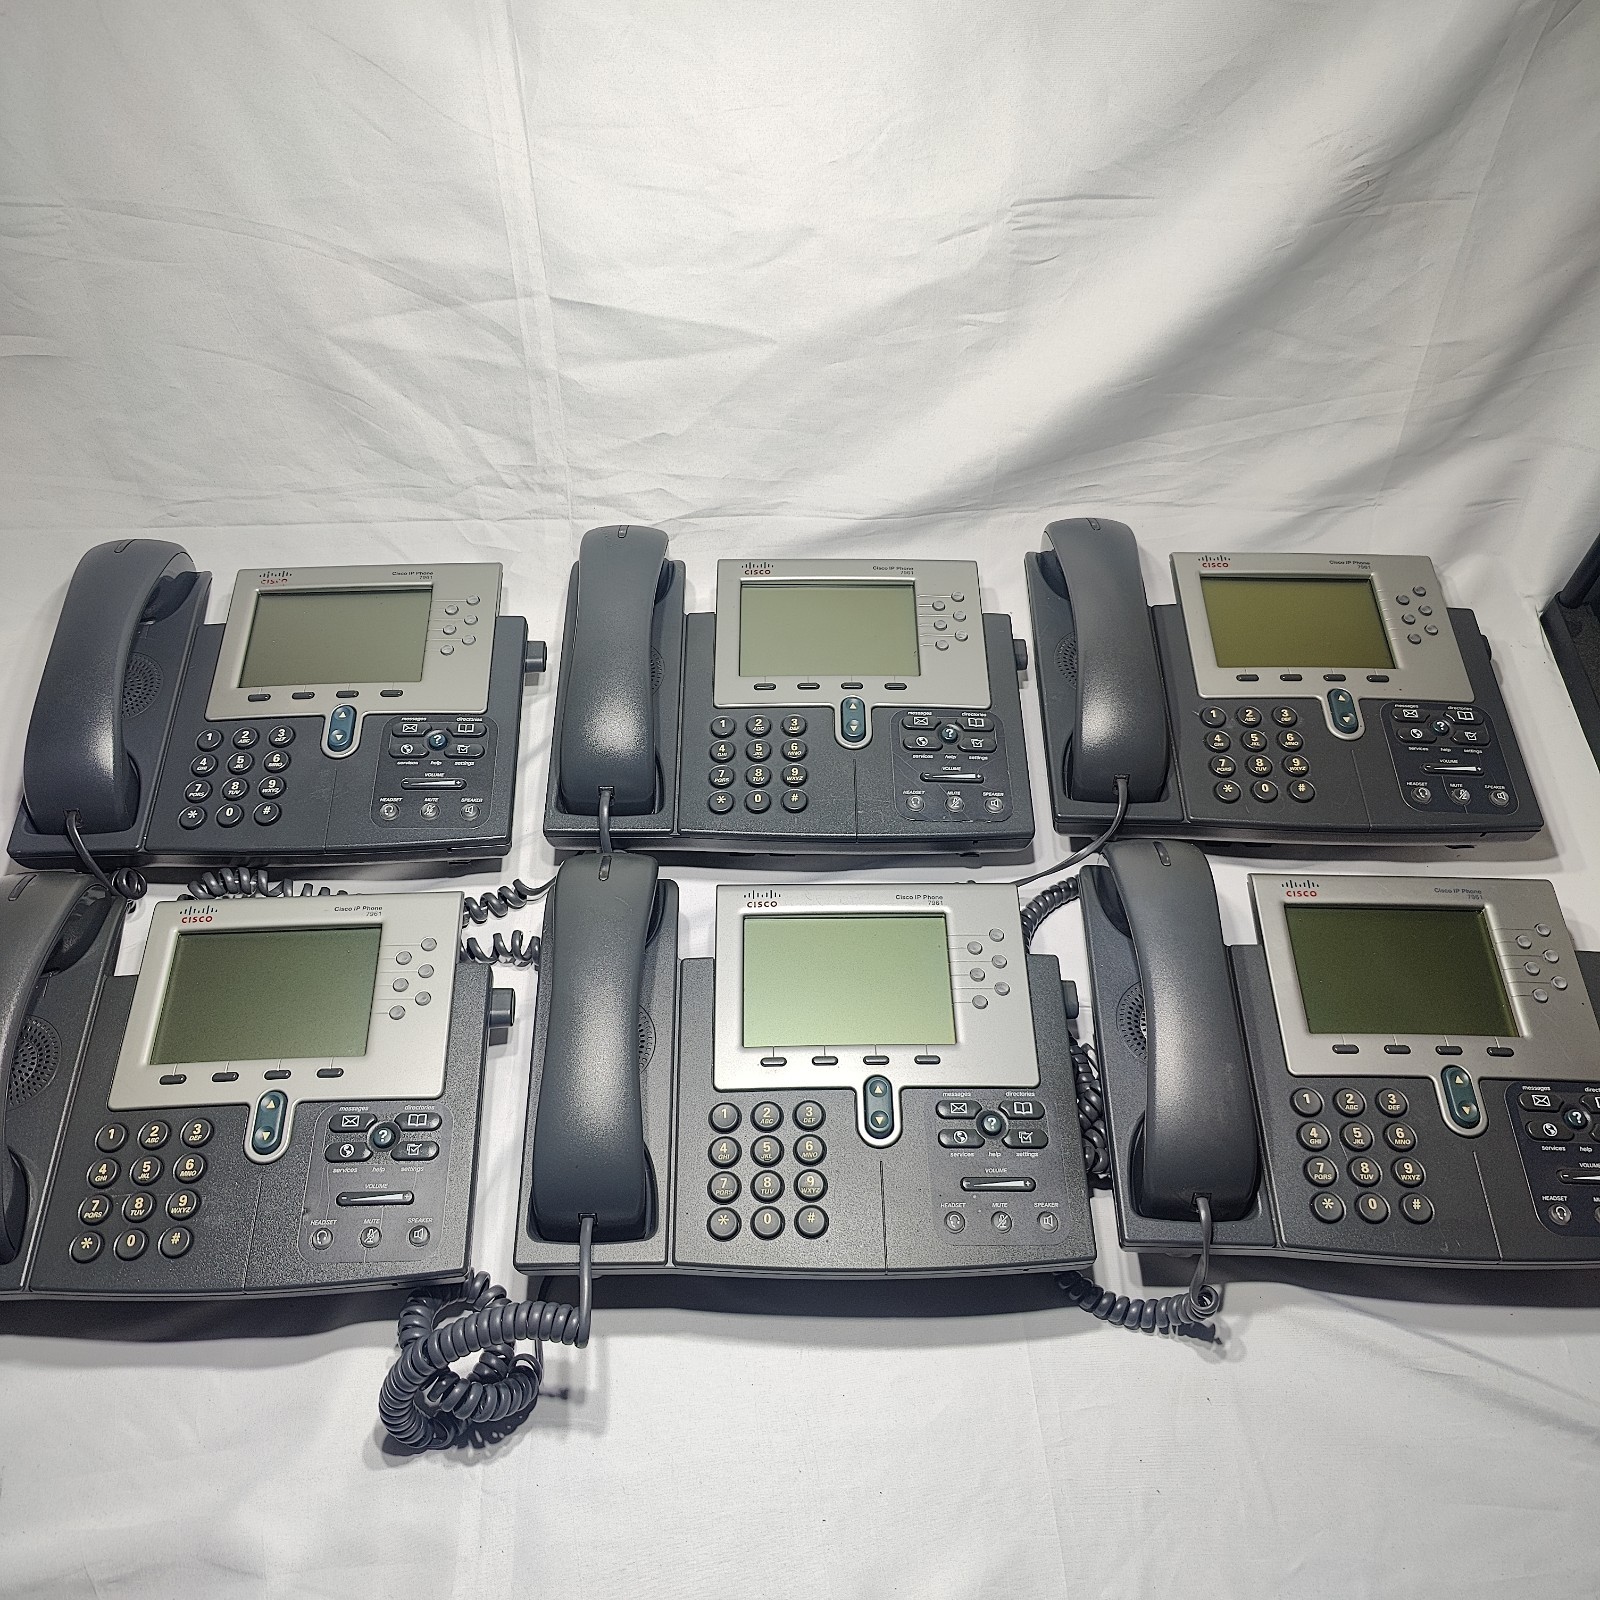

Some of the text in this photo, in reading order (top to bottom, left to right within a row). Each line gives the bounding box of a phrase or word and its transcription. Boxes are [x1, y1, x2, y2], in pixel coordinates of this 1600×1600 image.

[1210, 709, 1217, 718] 1
[1245, 709, 1254, 718] 2
[1281, 709, 1289, 717] 3
[720, 719, 726, 728] 1
[755, 718, 763, 727] 2
[791, 718, 798, 727] 3
[206, 732, 213, 741] 1
[241, 730, 250, 739] 2
[277, 728, 286, 737] 3
[1250, 733, 1259, 742] 5
[1286, 733, 1294, 742] 6
[1214, 734, 1222, 742] 4
[718, 744, 726, 753] 4
[755, 743, 763, 752] 5
[790, 742, 798, 751] 6
[199, 757, 207, 766] 4
[236, 755, 245, 764] 5
[272, 753, 281, 763] 6
[1218, 759, 1226, 767] 7
[1255, 758, 1264, 767] 8
[1292, 758, 1301, 767] 9
[718, 769, 725, 778] 7
[755, 768, 763, 777] 8
[791, 767, 799, 776] 9
[194, 783, 203, 792] 7
[231, 781, 240, 790] 8
[268, 779, 277, 788] 9
[1261, 783, 1269, 793] 0
[754, 793, 762, 803] 0
[225, 807, 234, 817] 0
[1286, 890, 1318, 898] CISCO
[746, 900, 778, 908] CISCO
[181, 915, 213, 924] CISCO
[1303, 1093, 1311, 1104] 1
[1345, 1093, 1355, 1104] 2
[1387, 1093, 1397, 1104] 3
[721, 1108, 727, 1119] 1
[763, 1107, 771, 1118] 2
[805, 1106, 813, 1117] 3
[108, 1128, 115, 1140] 1
[149, 1125, 160, 1137] 2
[192, 1123, 202, 1135] 3
[1309, 1127, 1319, 1138] 4
[1352, 1127, 1362, 1138] 5
[1395, 1127, 1405, 1139] 6
[144, 1136, 160, 1144] ABC
[719, 1142, 728, 1153] 4
[763, 1141, 771, 1153] 5
[805, 1140, 814, 1152] 6
[98, 1163, 107, 1175] 4
[141, 1161, 152, 1173] 5
[185, 1158, 195, 1171] 6
[1316, 1162, 1324, 1173] 7
[1360, 1162, 1370, 1173] 8
[1403, 1162, 1413, 1174] 9
[137, 1172, 151, 1180] JKL
[806, 1175, 815, 1187] 9
[720, 1177, 728, 1189] 7
[763, 1176, 772, 1188] 8
[91, 1199, 100, 1212] 7
[134, 1197, 144, 1209] 8
[178, 1194, 188, 1207] 9
[1368, 1198, 1378, 1210] 0
[83, 1211, 103, 1219] PQRS
[170, 1206, 192, 1214] WXYZ
[763, 1212, 772, 1225] 0
[126, 1234, 136, 1247] 0
